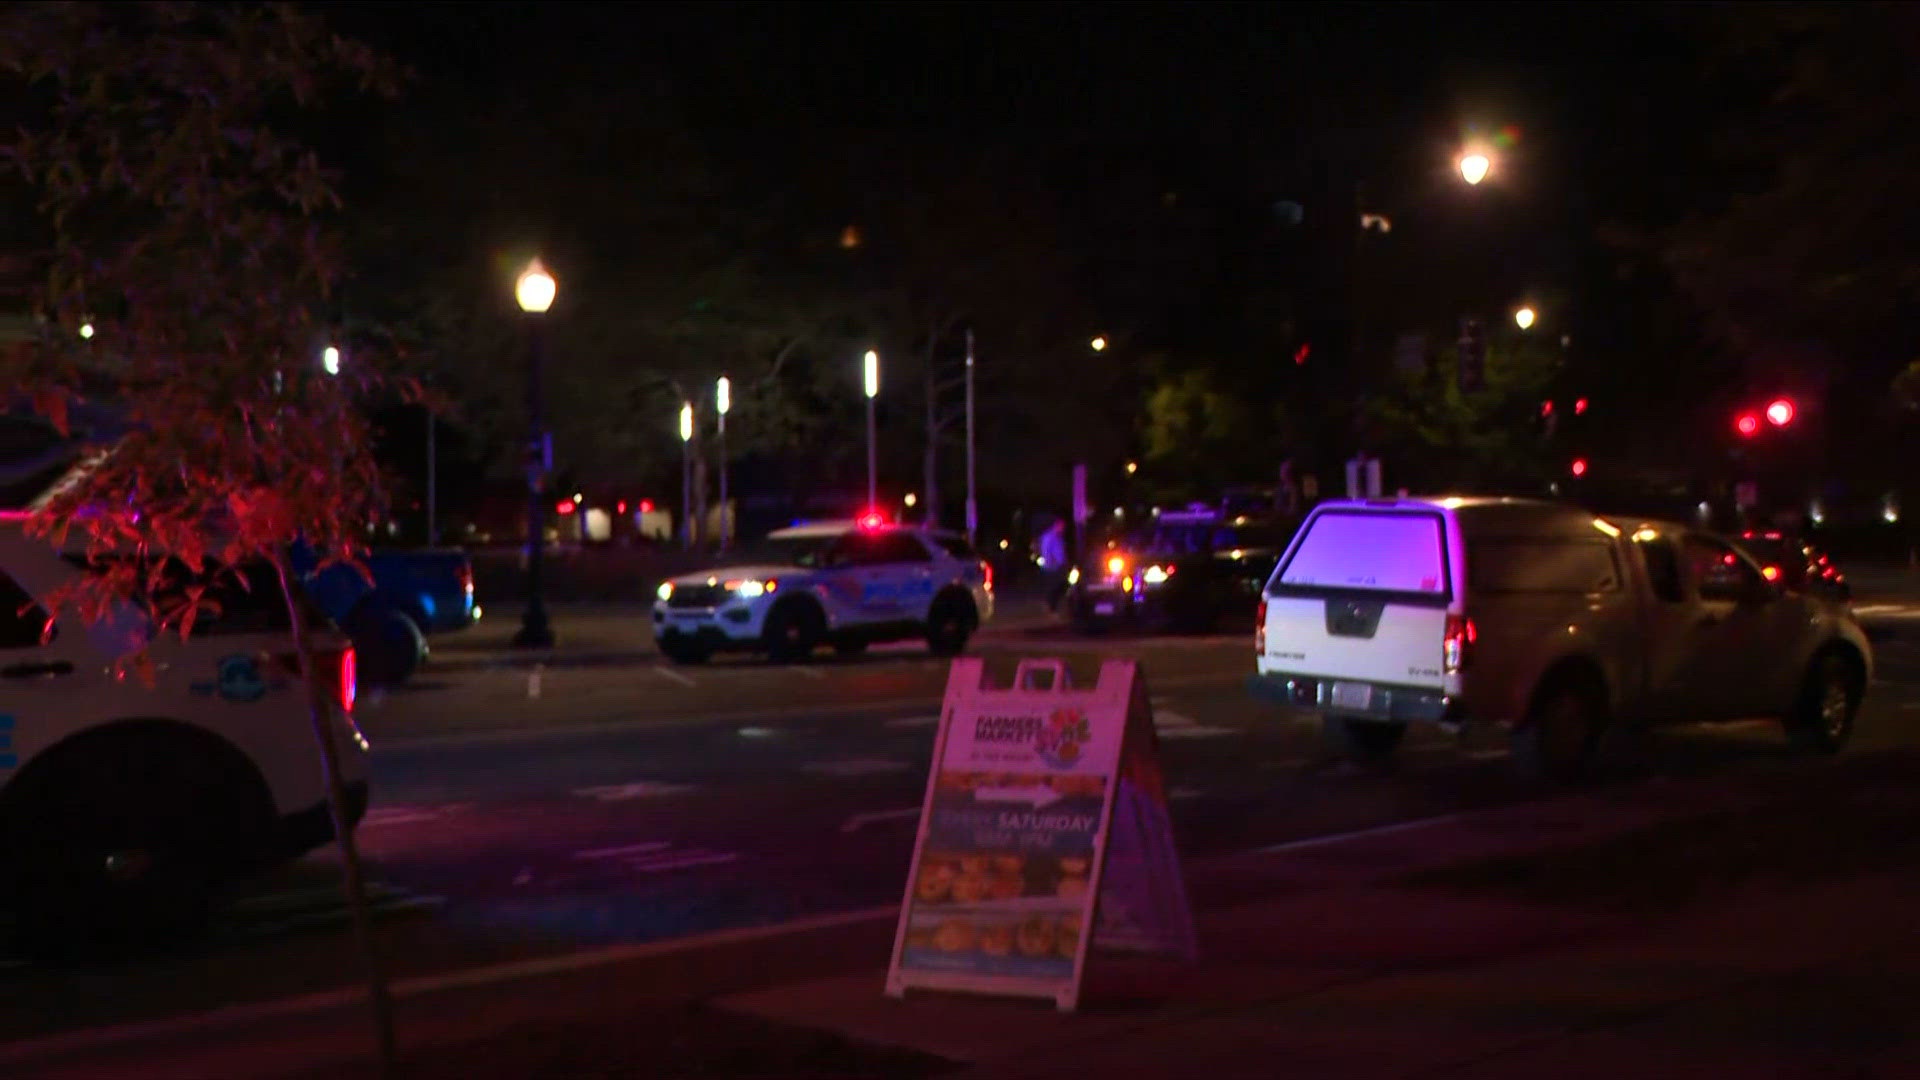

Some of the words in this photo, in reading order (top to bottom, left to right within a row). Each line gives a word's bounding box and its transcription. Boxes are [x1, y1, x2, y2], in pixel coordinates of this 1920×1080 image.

[976, 715, 1042, 729] FARMERS
[975, 728, 1034, 743] MARKET
[998, 811, 1094, 832] SATURDAY
